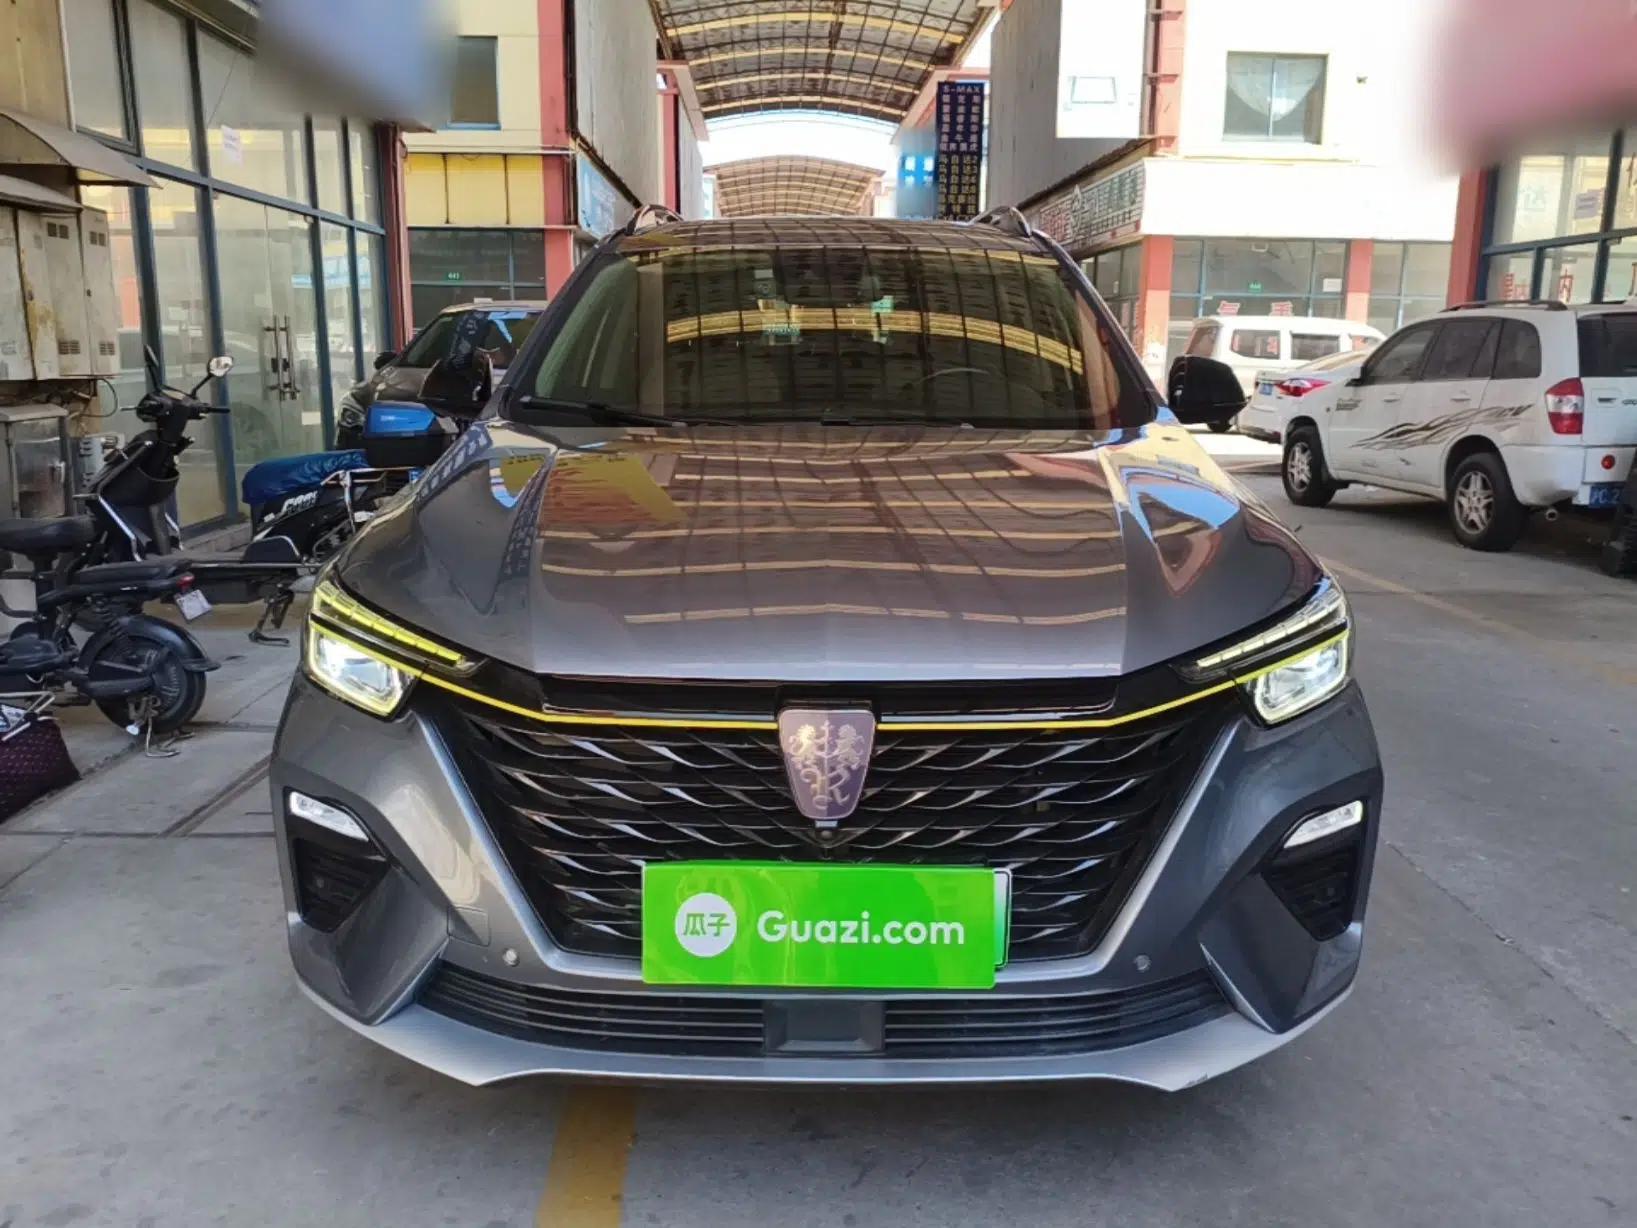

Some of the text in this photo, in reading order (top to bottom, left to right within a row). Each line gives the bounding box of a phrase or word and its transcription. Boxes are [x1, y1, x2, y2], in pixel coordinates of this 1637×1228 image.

[942, 84, 981, 93] S-MAX
[682, 912, 731, 938] 瓜子
[757, 910, 965, 945] Guazi.com
